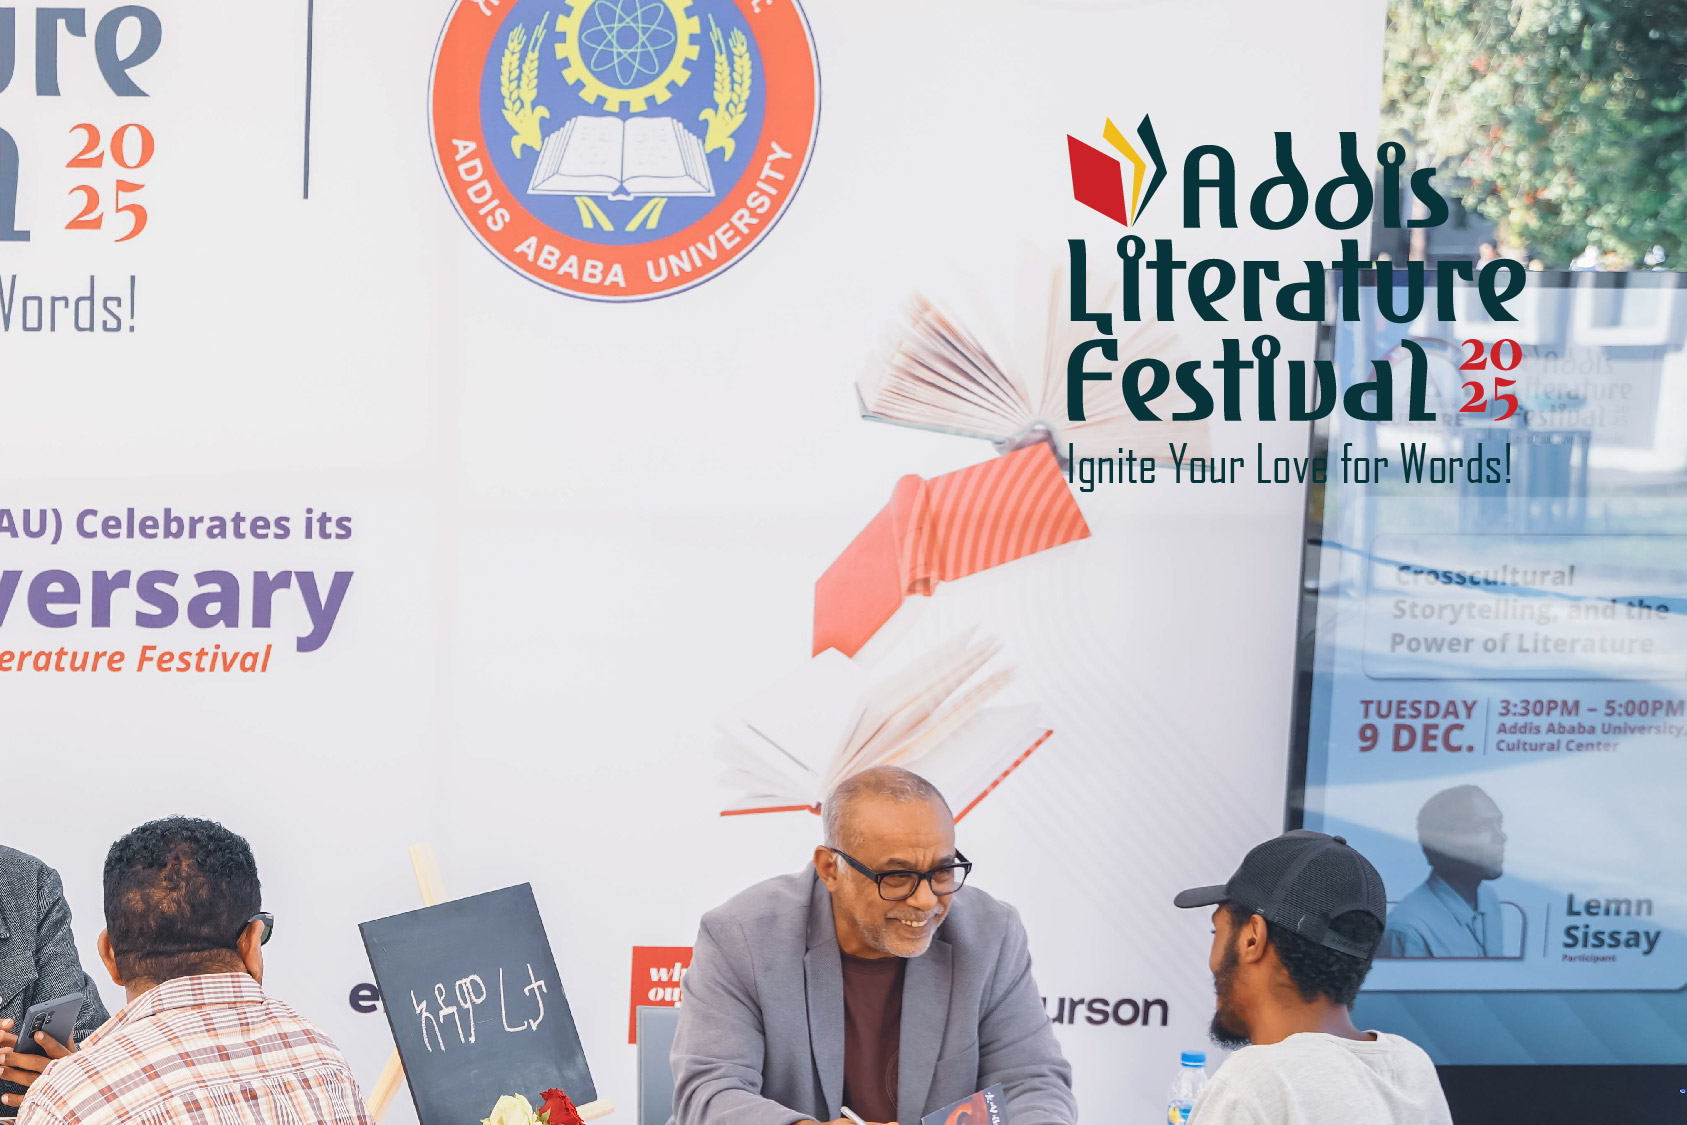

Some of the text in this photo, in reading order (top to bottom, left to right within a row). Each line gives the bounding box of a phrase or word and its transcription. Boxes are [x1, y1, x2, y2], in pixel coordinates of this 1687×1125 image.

[66, 123, 154, 169] 20
[65, 179, 147, 242] 25
[452, 137, 794, 288] ADDIS ABABA UNIVERSITY
[73, 504, 296, 544] Celebrates
[302, 504, 354, 544] its
[1394, 564, 1575, 587] Crosscultural
[1570, 598, 1617, 620] and
[1626, 598, 1670, 620] the
[1390, 630, 1655, 654] Power of Literature
[135, 638, 272, 675] Festival
[1359, 699, 1478, 720] TUESDAY
[1497, 699, 1580, 718] 3:30PM
[1603, 699, 1685, 718] 5:00PM
[1358, 723, 1474, 753] 9 DEC.
[1496, 721, 1541, 736] Addis
[1545, 721, 1596, 736] Ababa
[1495, 739, 1620, 752] Cultural Center
[1566, 893, 1653, 916] Lemn
[1563, 924, 1661, 956] Sissay
[1562, 954, 1616, 963] Participant
[1041, 997, 1168, 1026] urson
